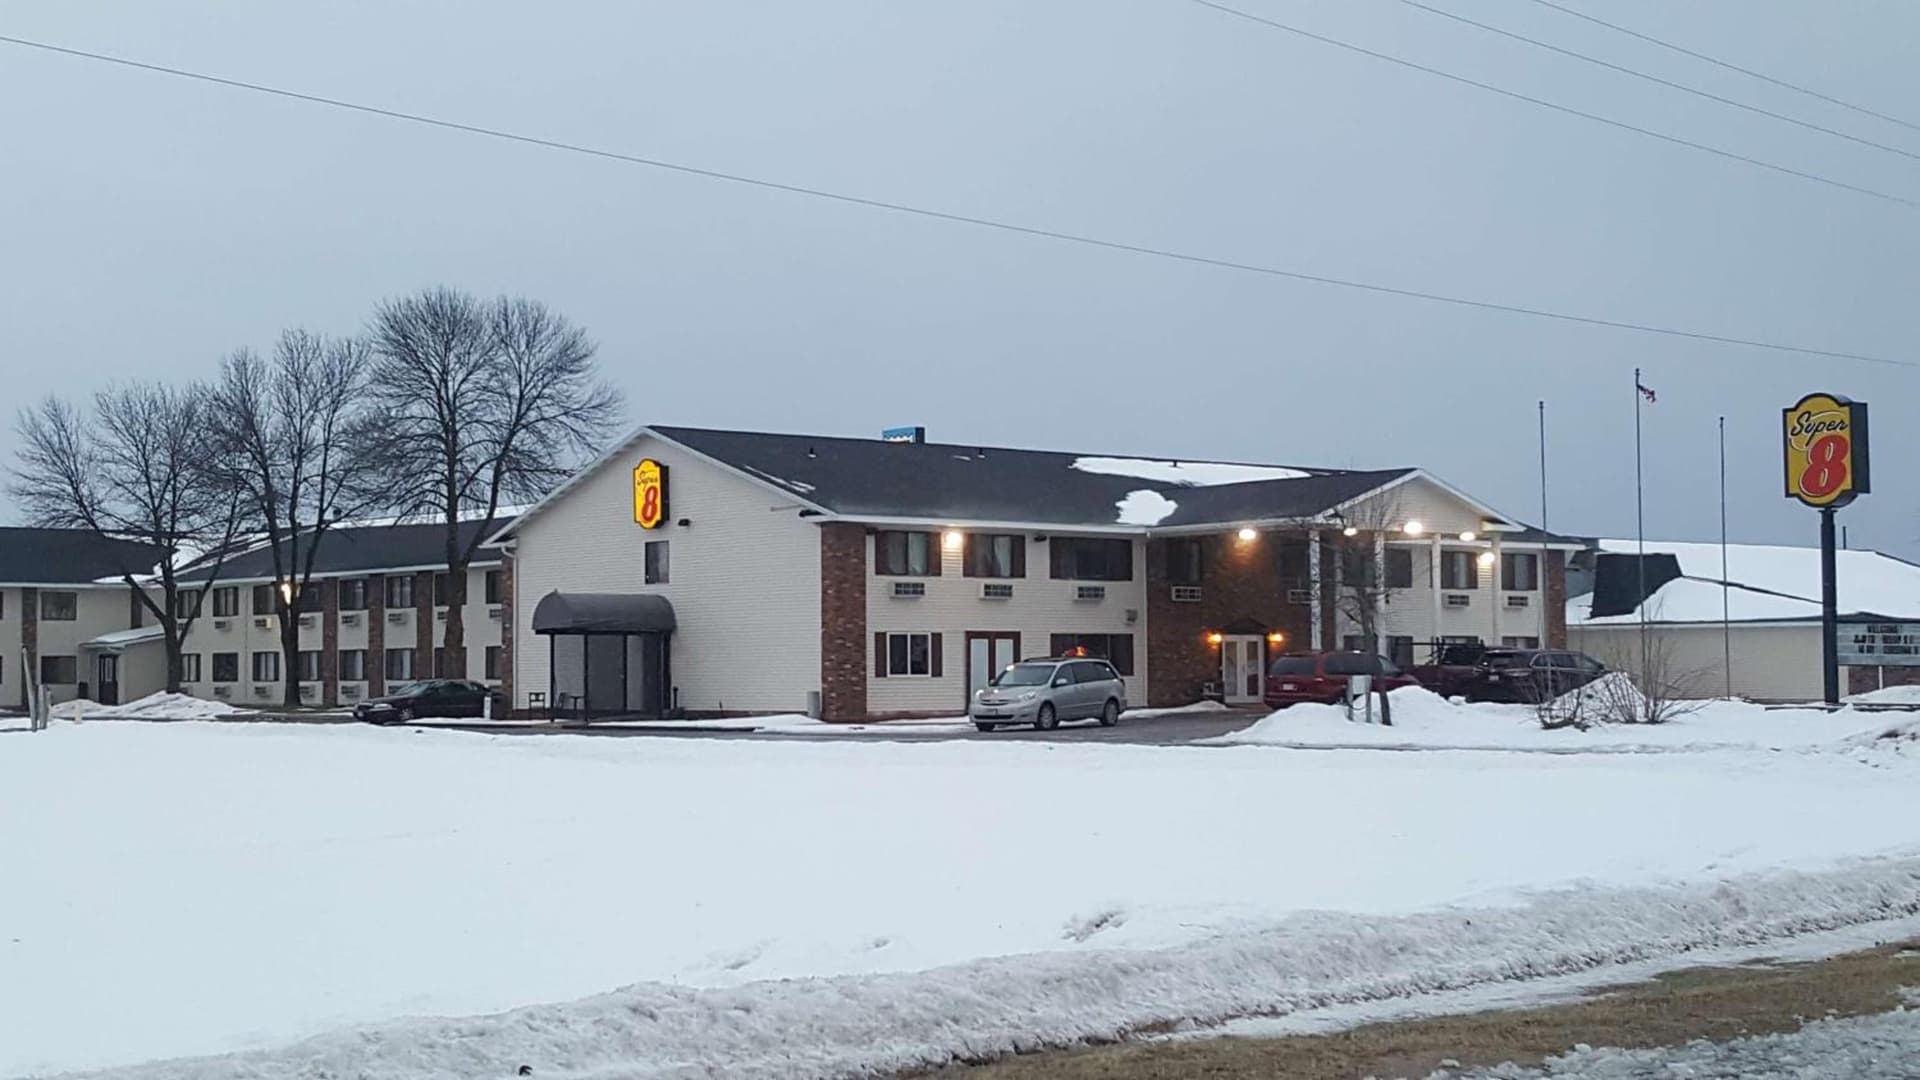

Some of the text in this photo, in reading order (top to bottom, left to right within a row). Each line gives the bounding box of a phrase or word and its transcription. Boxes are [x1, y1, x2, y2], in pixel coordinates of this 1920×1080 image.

[1790, 410, 1849, 447] Super
[1799, 434, 1850, 497] 8
[641, 486, 658, 523] 8
